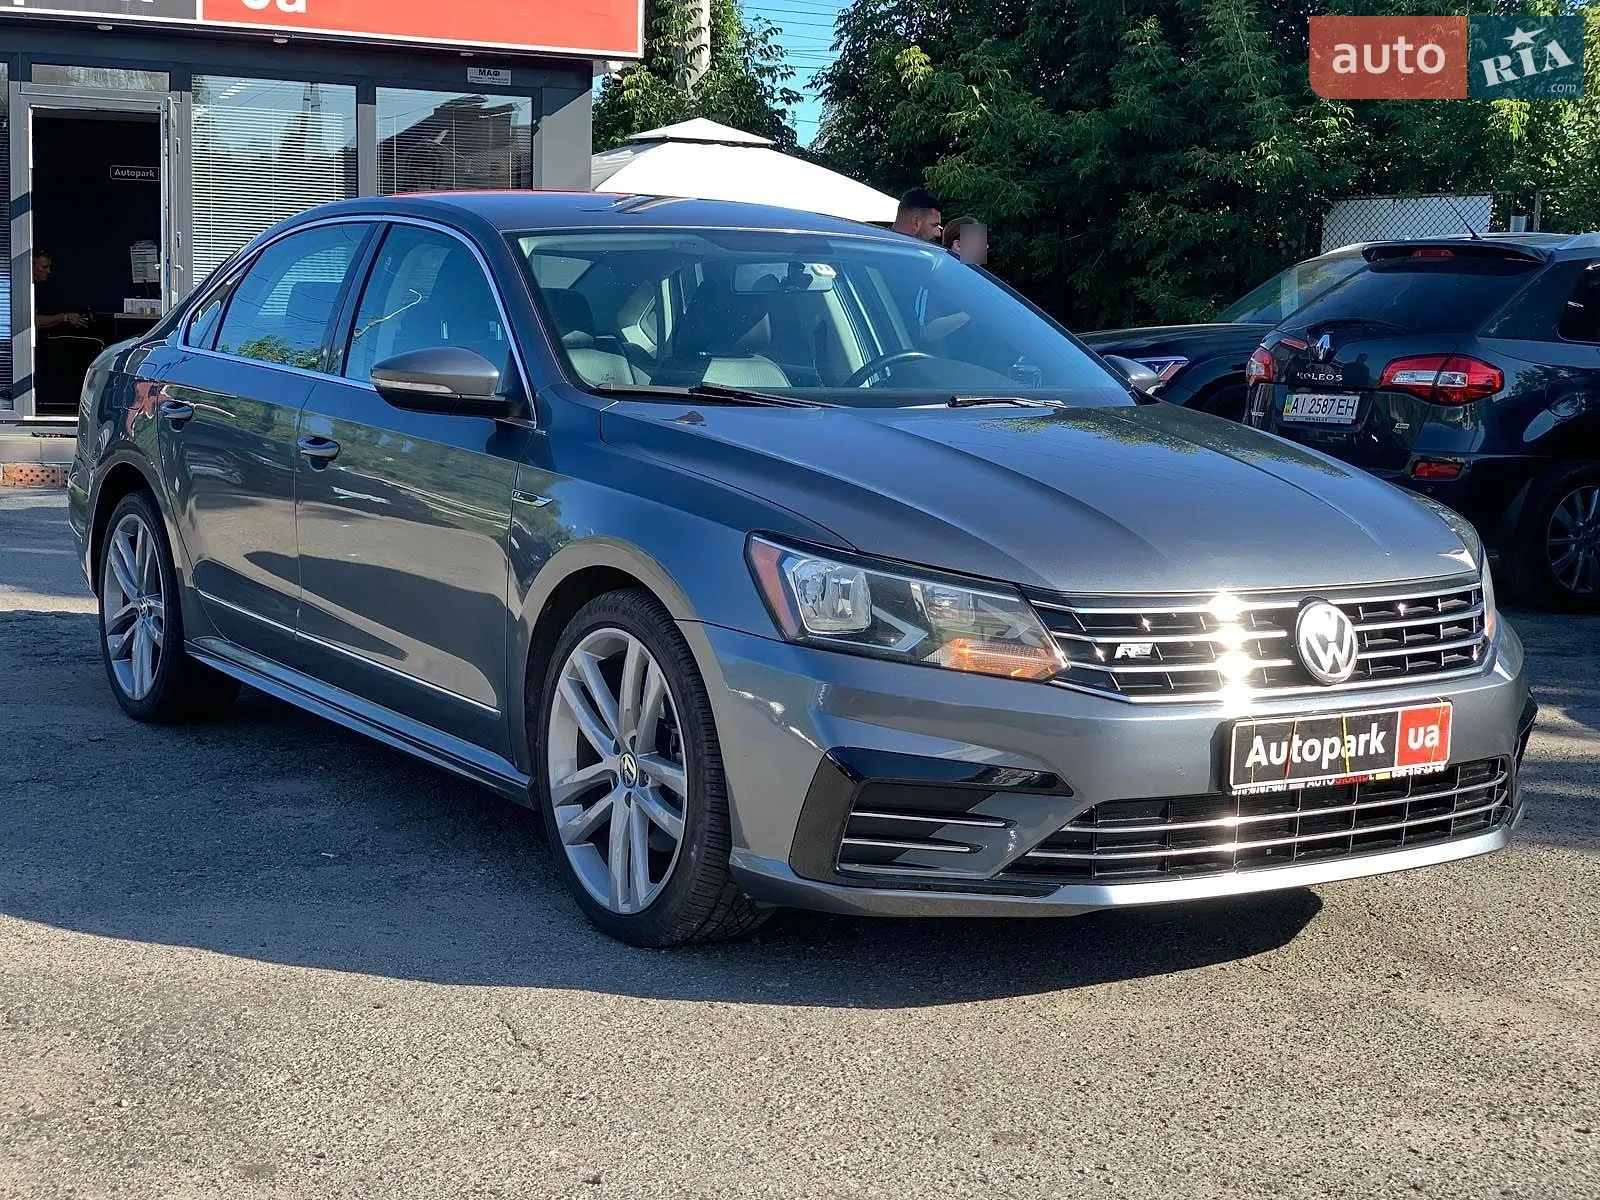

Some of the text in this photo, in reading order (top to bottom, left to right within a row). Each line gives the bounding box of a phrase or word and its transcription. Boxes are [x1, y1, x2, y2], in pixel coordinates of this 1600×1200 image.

[114, 168, 155, 179] Autopark
[1296, 371, 1344, 382] KOLEOS
[1308, 398, 1335, 415] 2587
[1244, 722, 1440, 770] Autopark ua
